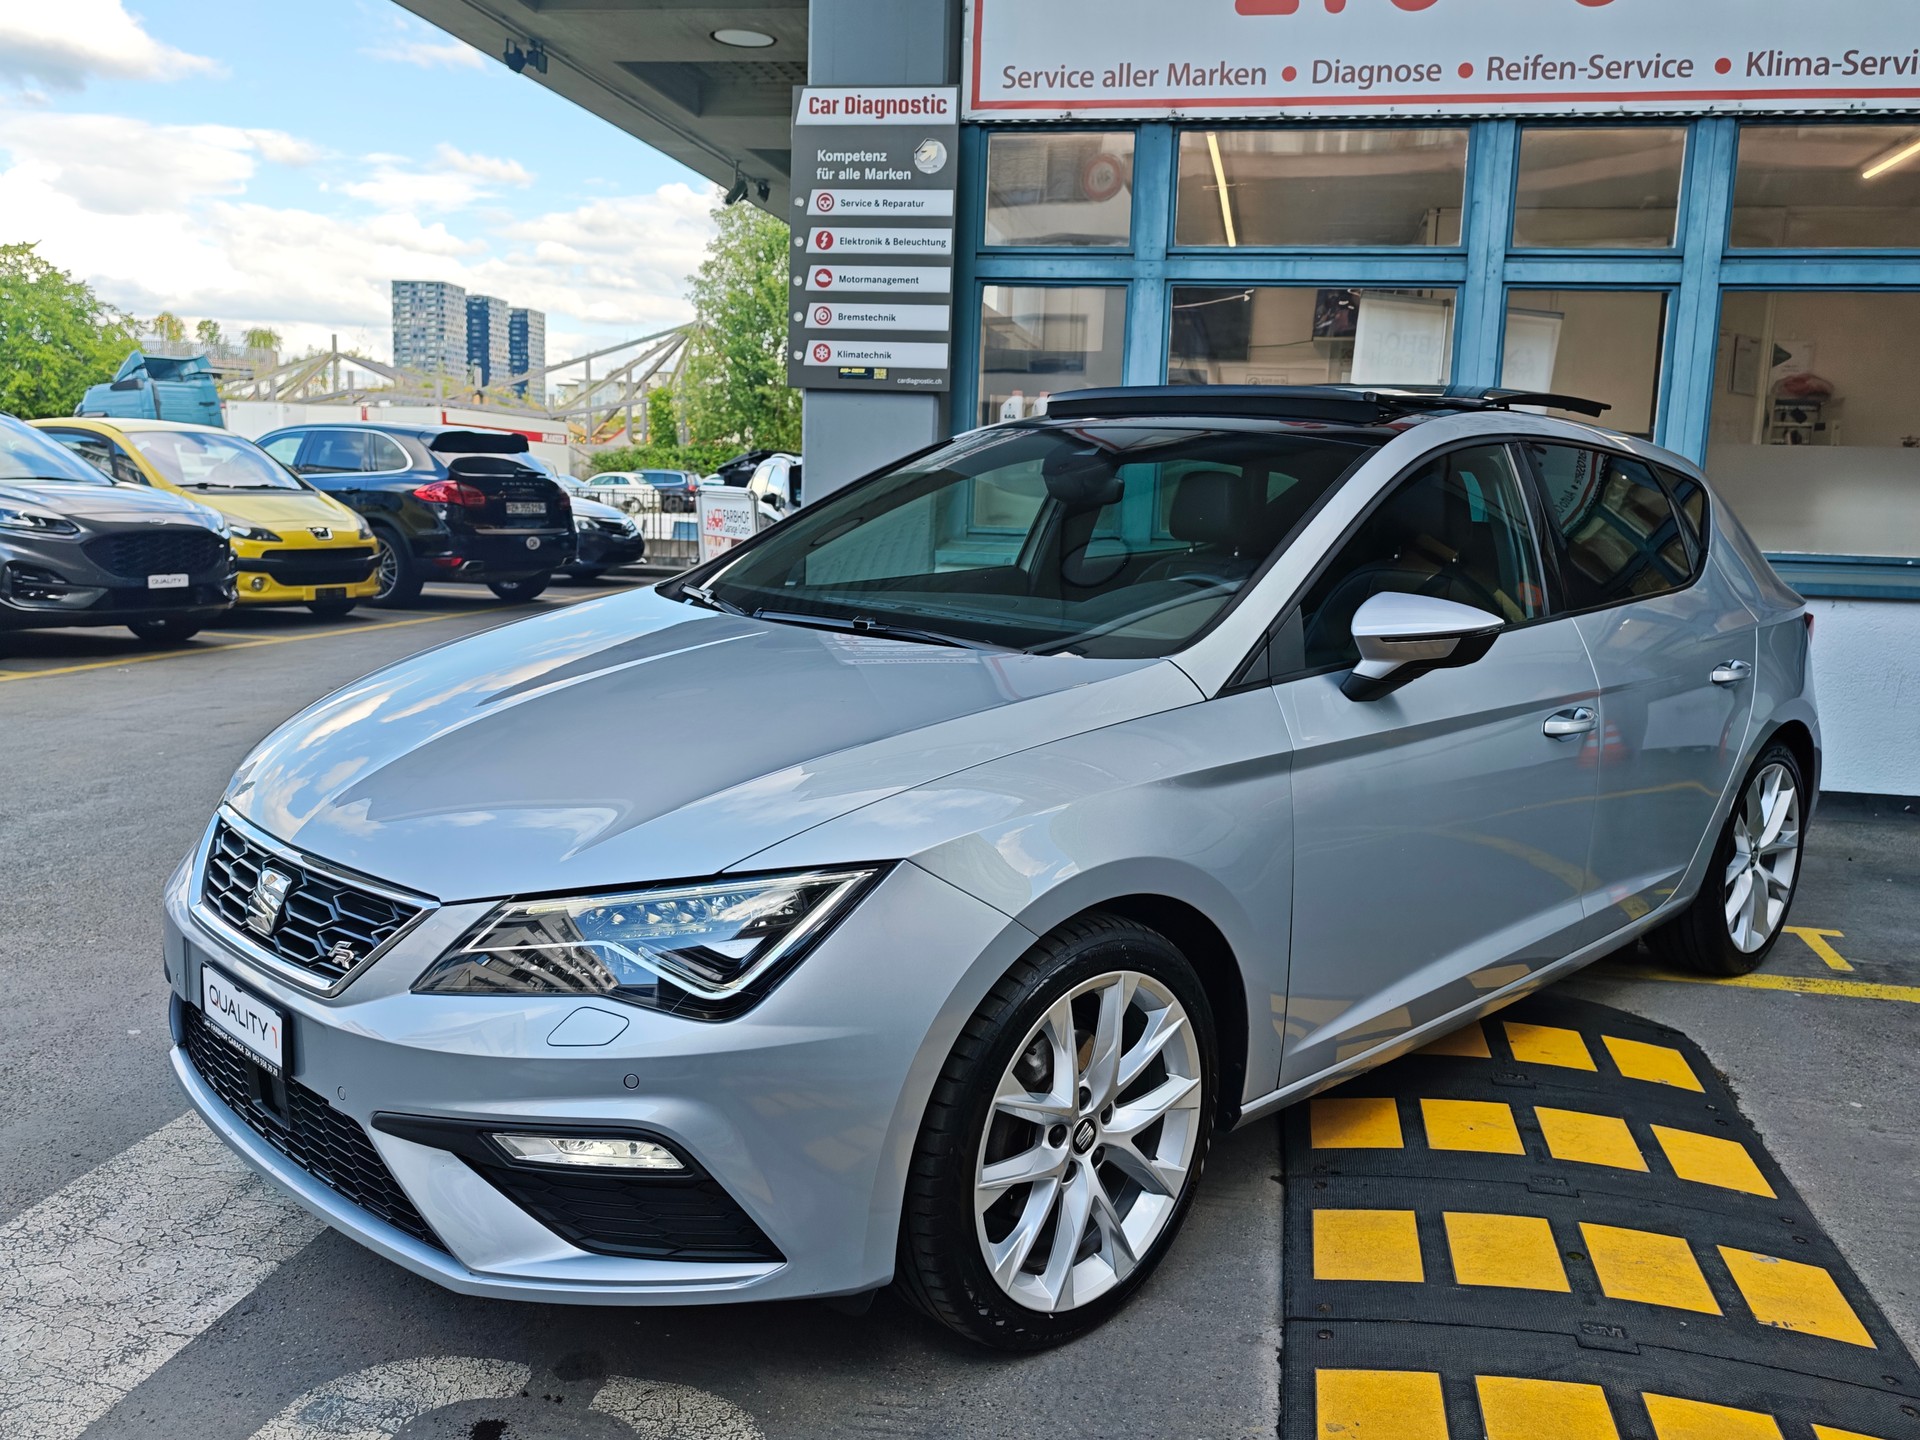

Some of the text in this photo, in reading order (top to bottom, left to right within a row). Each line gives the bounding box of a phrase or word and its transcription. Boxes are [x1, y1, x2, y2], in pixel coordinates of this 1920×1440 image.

[1002, 49, 1920, 91] Service aller Marken Diagnose Reifen-Service Klima-Servi
[808, 93, 948, 119] Car Diagnostic
[817, 150, 887, 164] Kompetenz
[816, 168, 912, 180] für alle Marken
[840, 199, 925, 209] Service & Reparatur
[839, 237, 947, 248] Elektronik & Beleuchtung
[838, 275, 919, 286] Motormanagement
[837, 312, 896, 322] Bremstechnik
[837, 350, 892, 360] Klimatechnik
[897, 377, 943, 386] cardiagnostic.ch
[208, 984, 268, 1041] QUALITY
